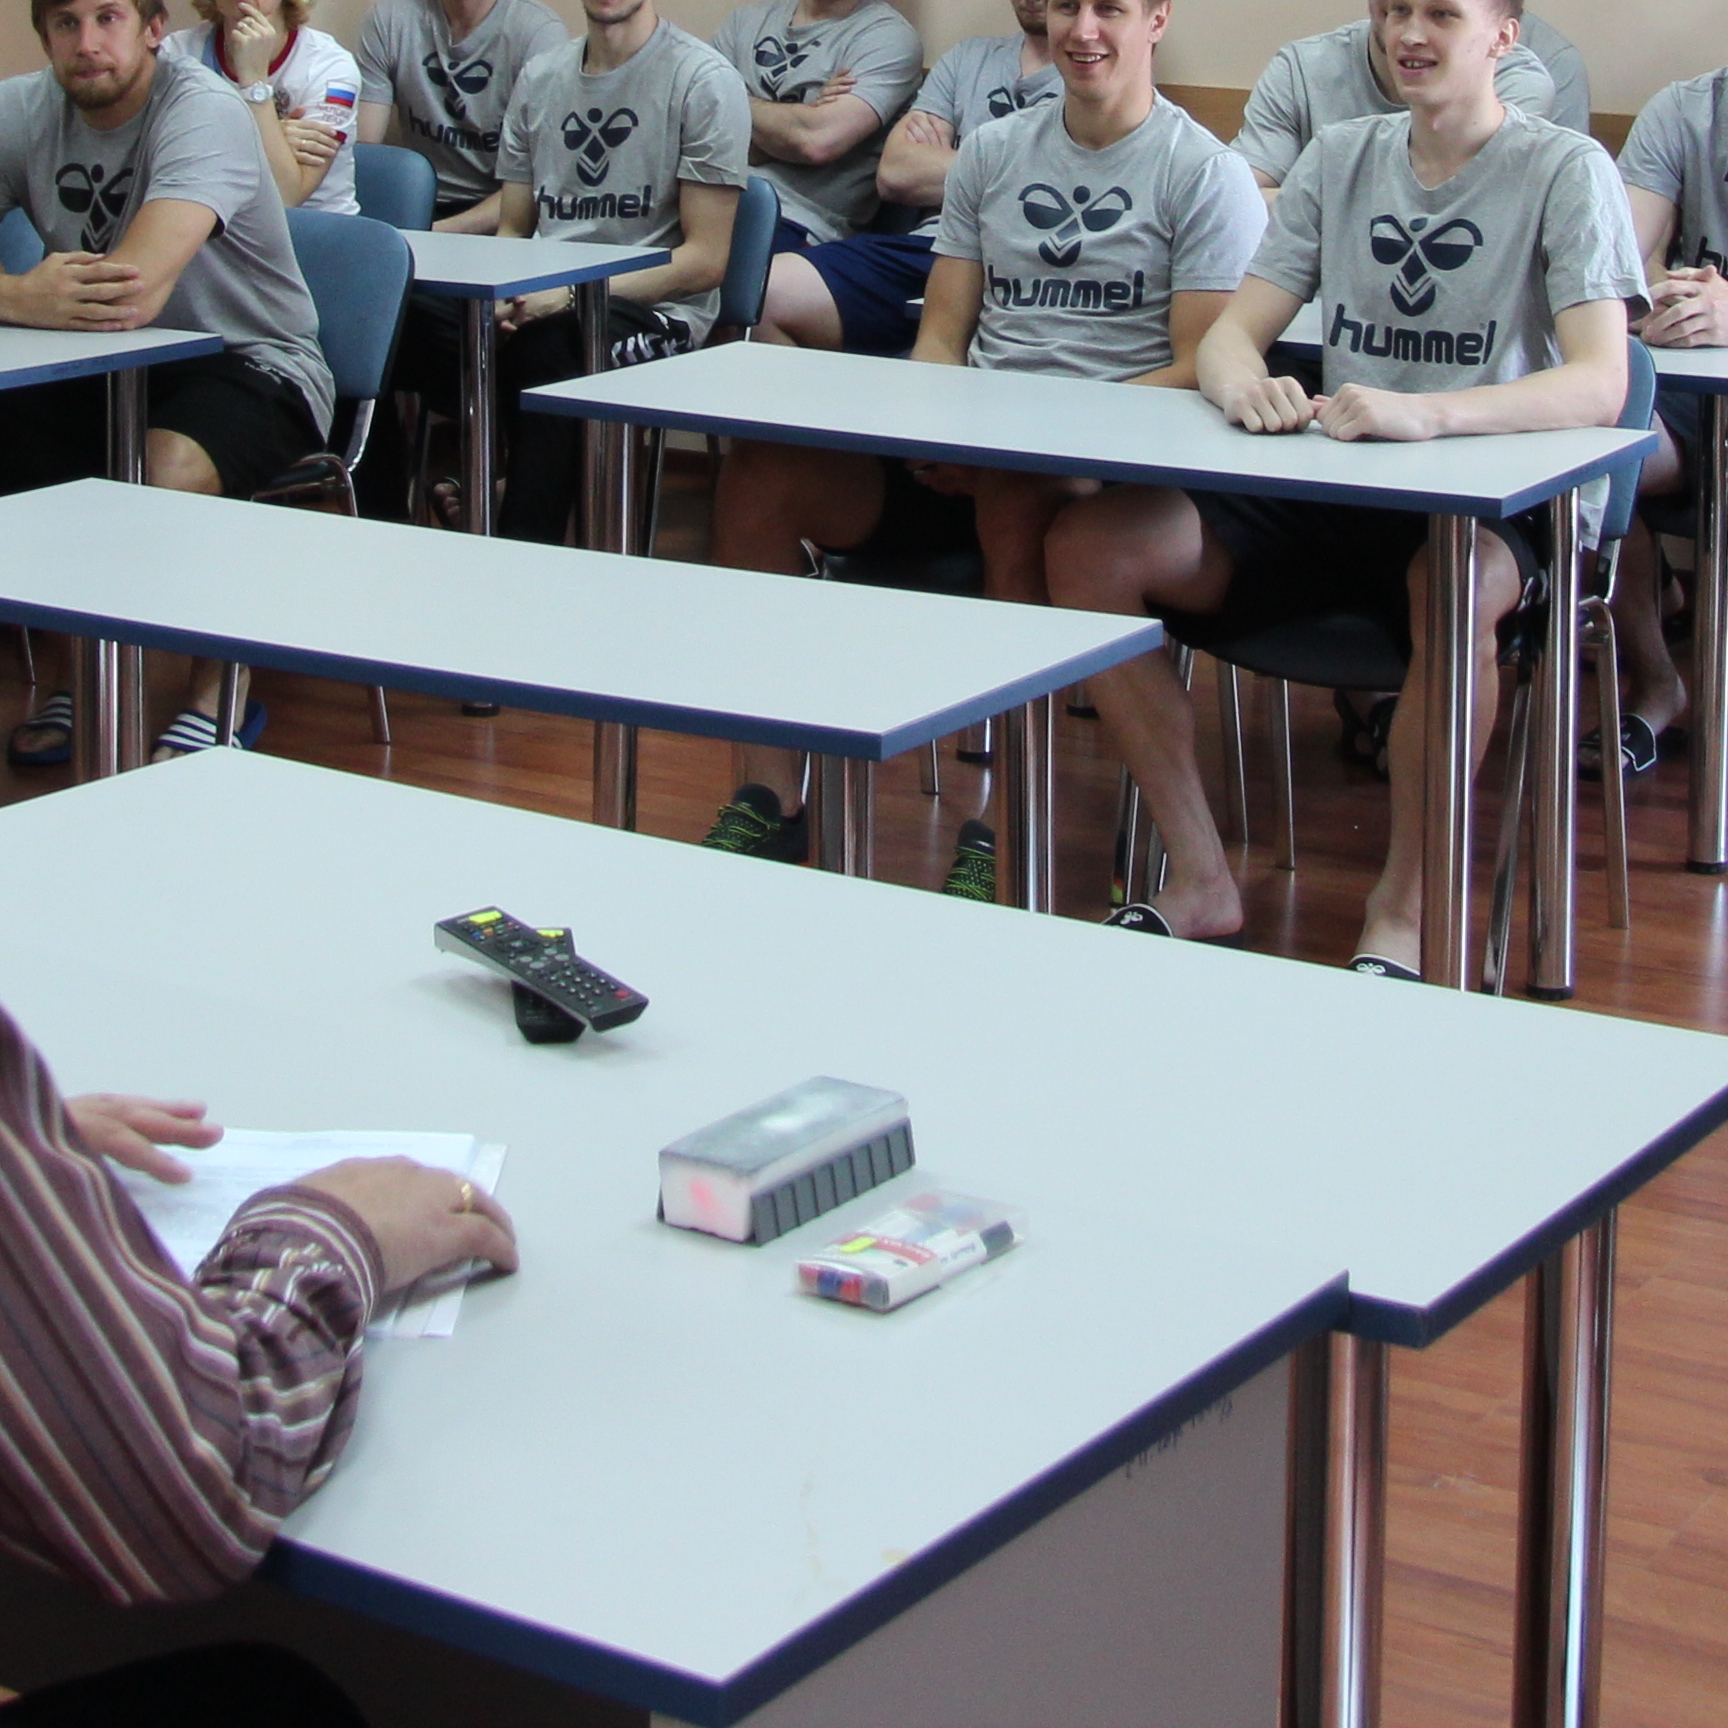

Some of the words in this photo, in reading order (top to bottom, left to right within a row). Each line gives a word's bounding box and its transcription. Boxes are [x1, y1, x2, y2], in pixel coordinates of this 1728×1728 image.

[408, 106, 503, 153] humme
[536, 184, 653, 221] hummel
[988, 264, 1145, 310] hummel
[1328, 303, 1498, 366] hummel
